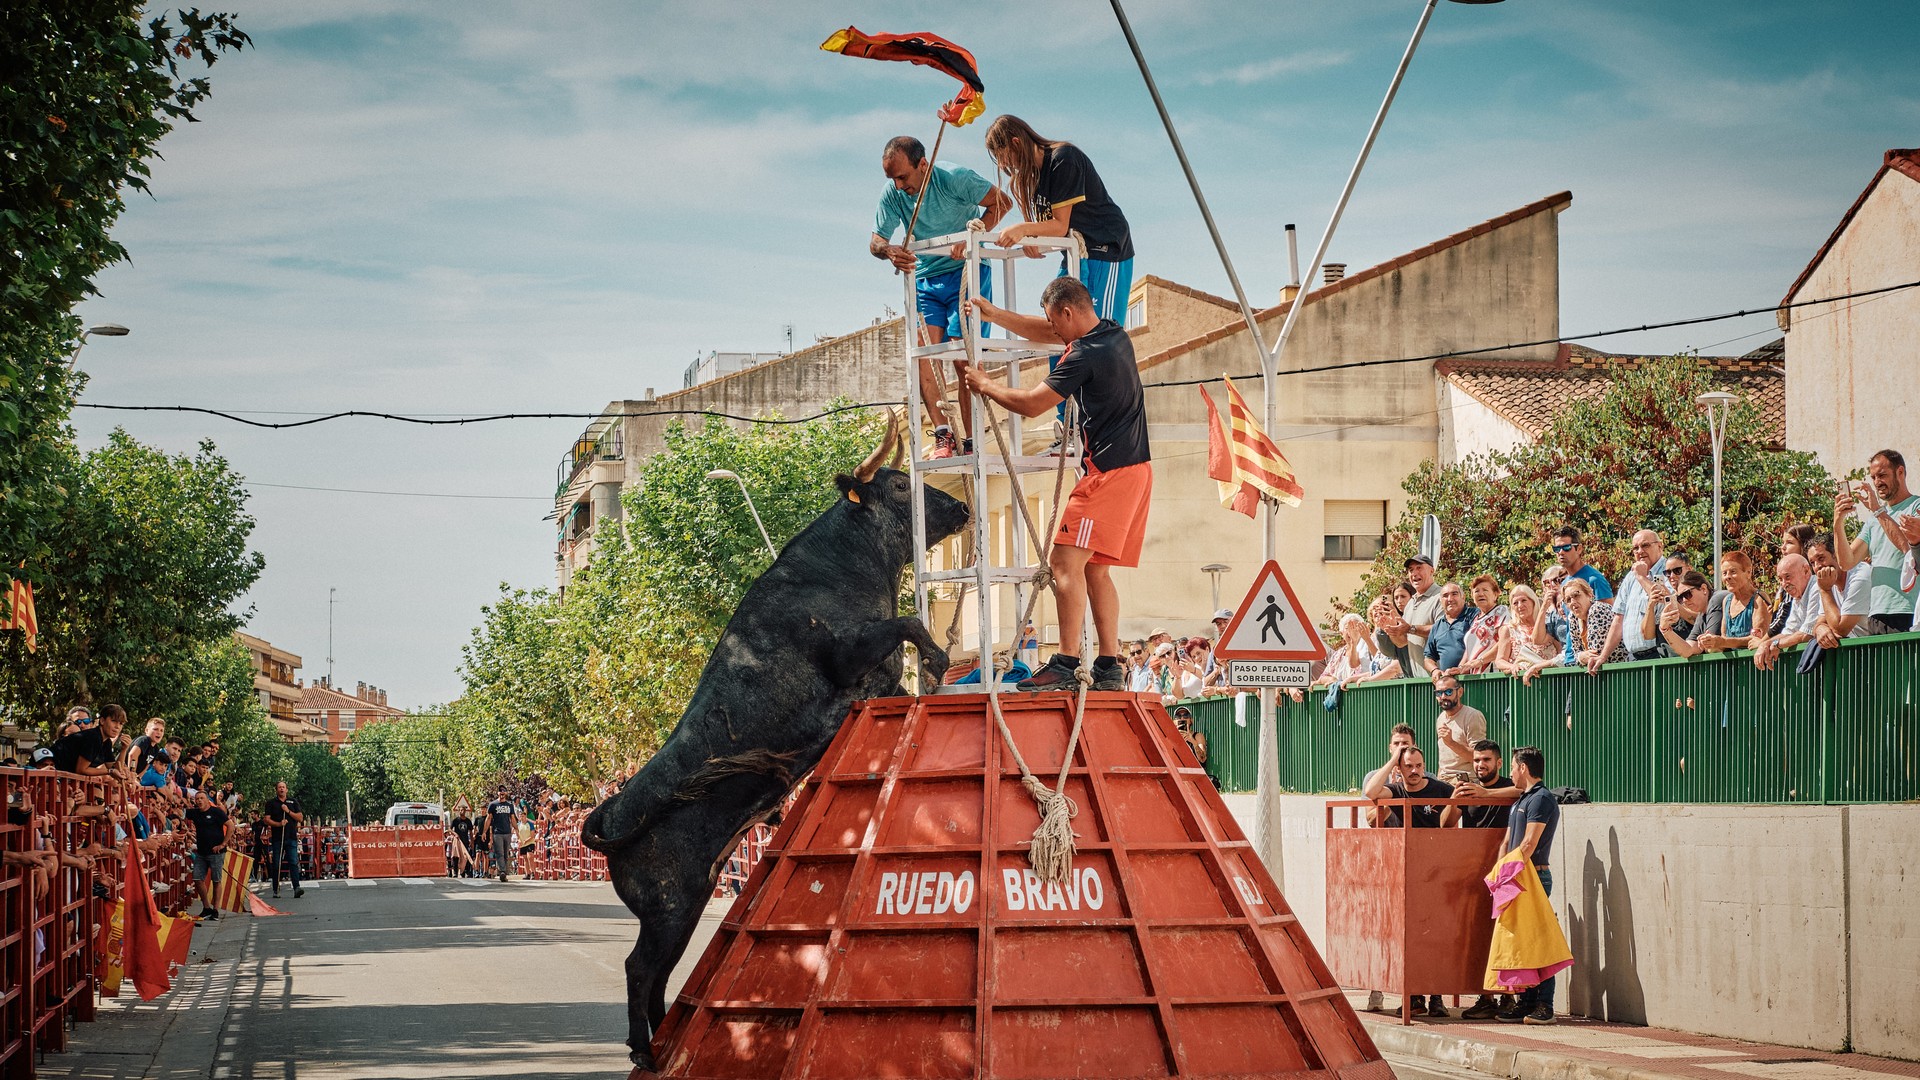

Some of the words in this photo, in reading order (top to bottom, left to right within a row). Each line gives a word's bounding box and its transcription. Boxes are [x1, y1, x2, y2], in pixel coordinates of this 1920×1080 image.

[1262, 665, 1307, 673] PEATONAL
[1236, 675, 1305, 683] SOBREELEVADO
[876, 870, 974, 915] RUEDO
[1002, 867, 1104, 911] BRAVO
